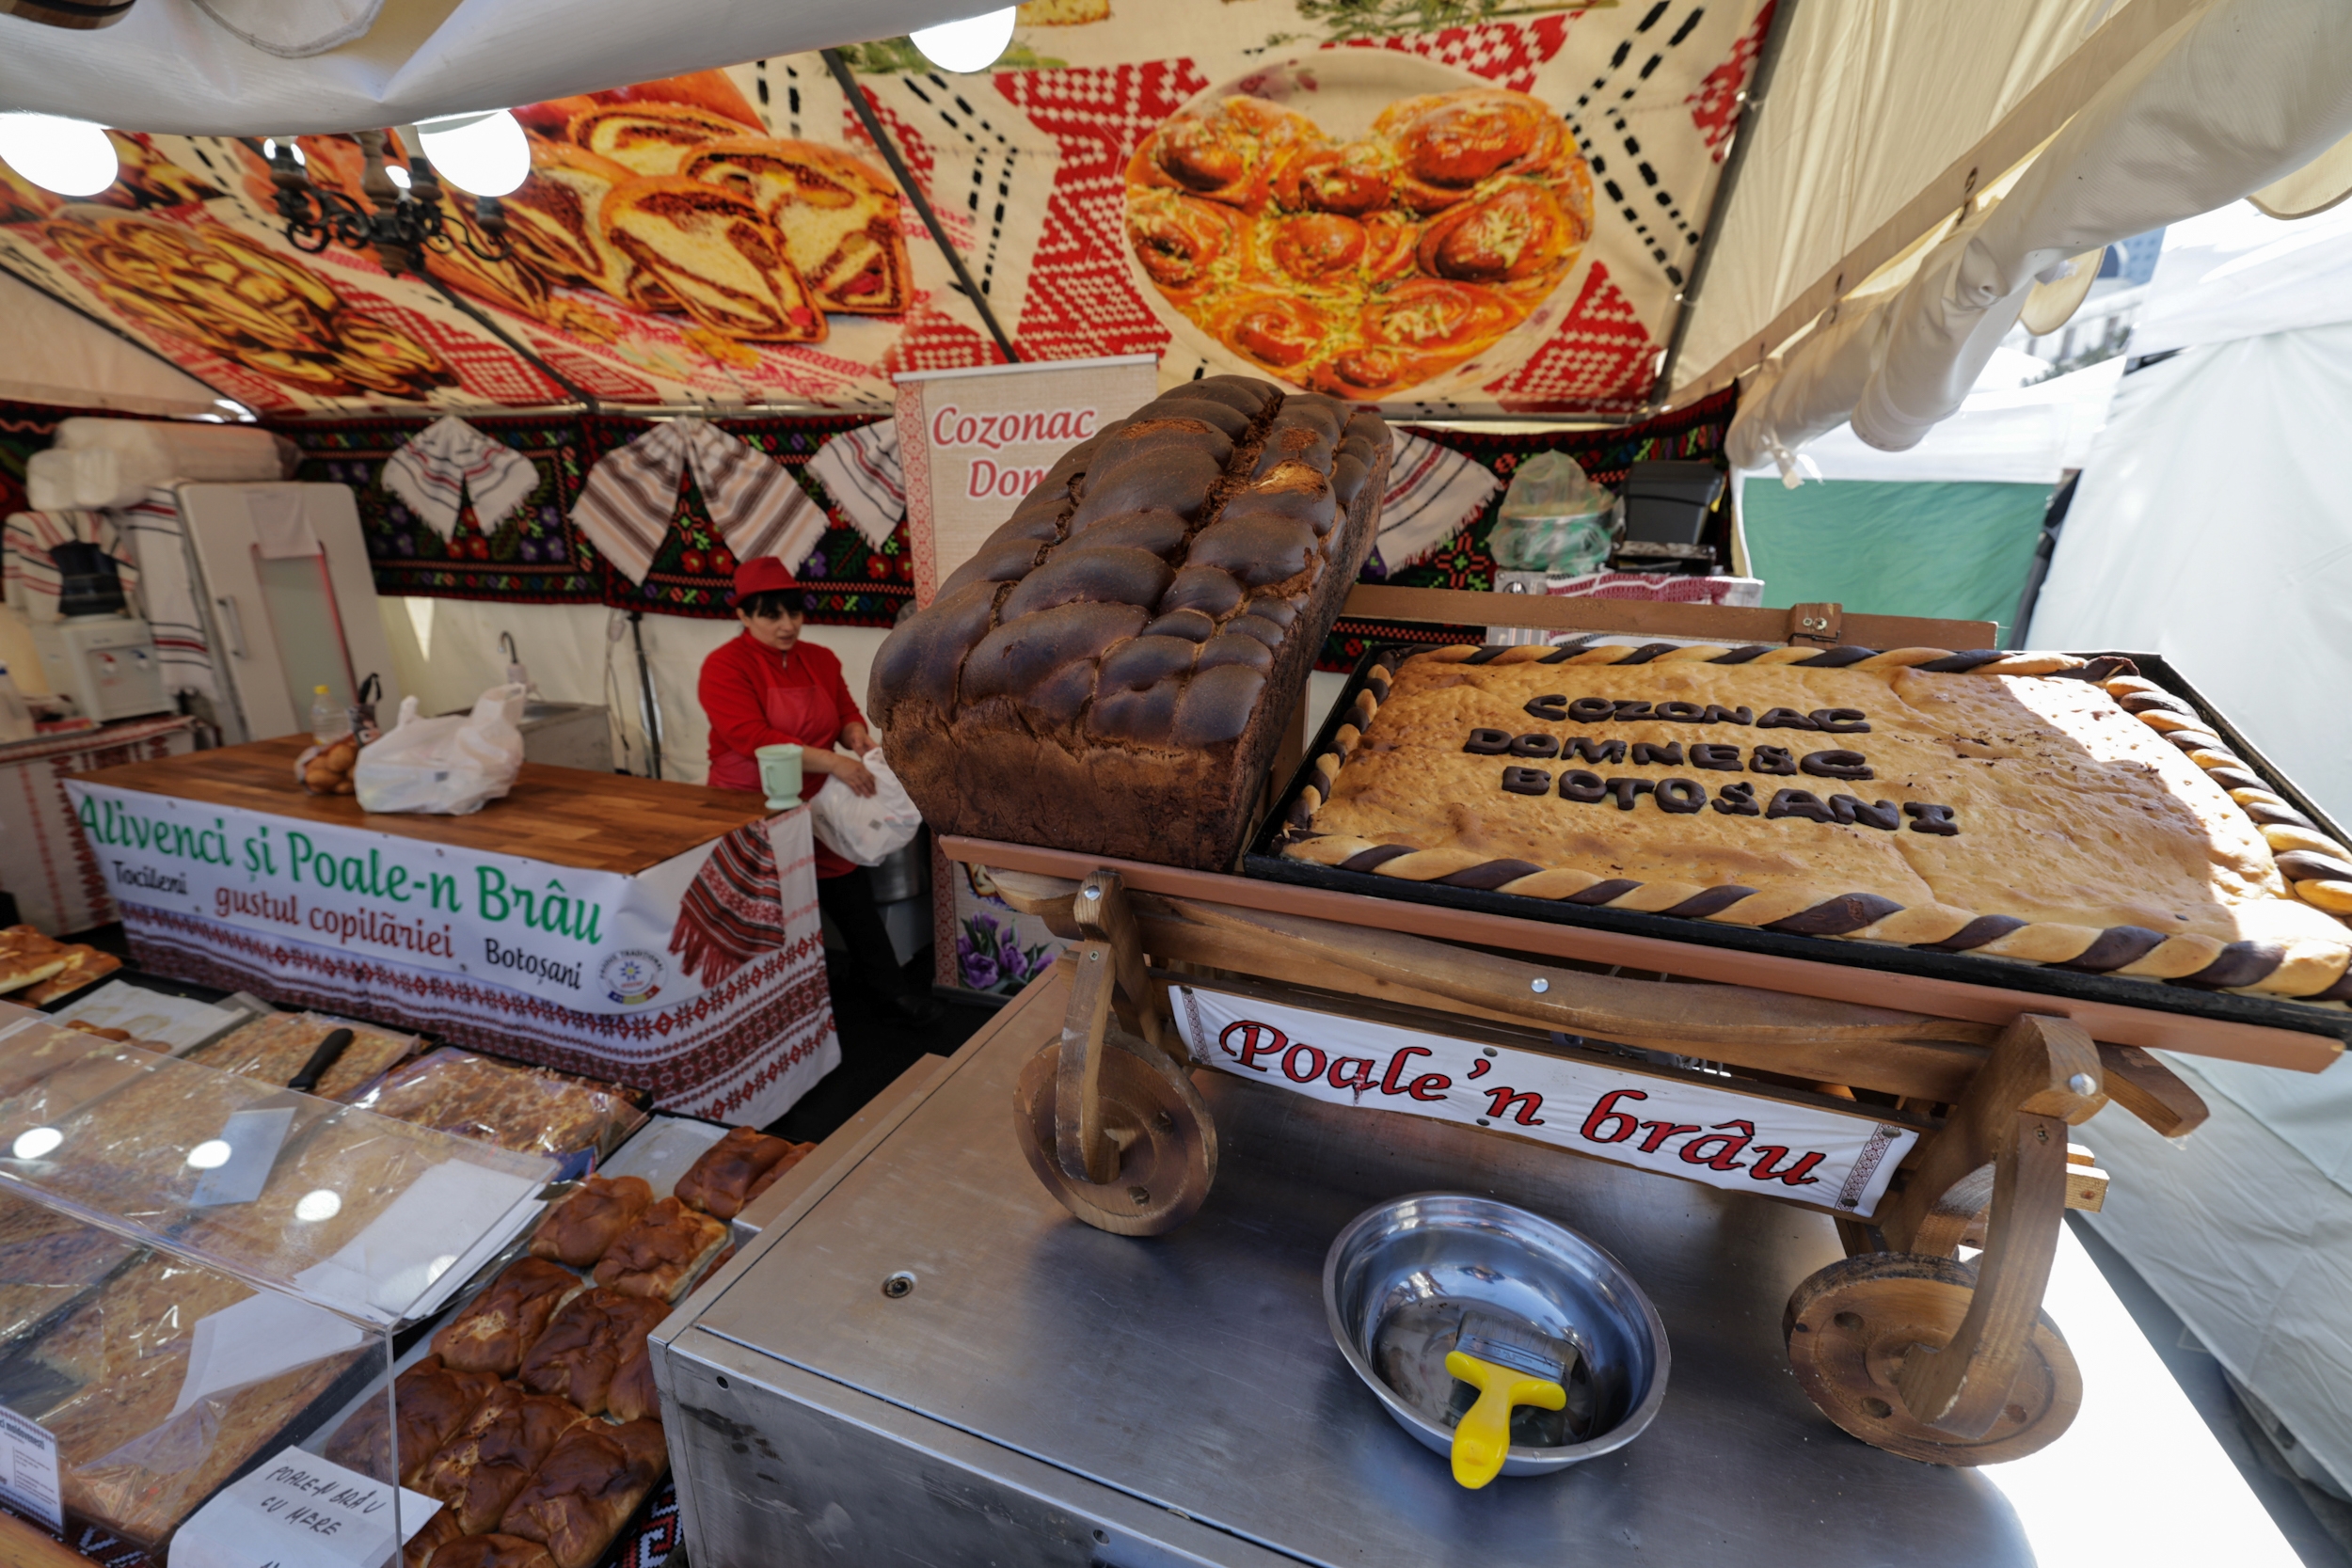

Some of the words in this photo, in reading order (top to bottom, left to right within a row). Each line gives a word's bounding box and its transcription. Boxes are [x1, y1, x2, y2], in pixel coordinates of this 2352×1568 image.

[932, 406, 1095, 450] Cozonac
[1523, 694, 1871, 733] COZONAC
[1463, 728, 1874, 780] DOMNESC
[1502, 765, 1959, 835] BOTOSANI
[79, 795, 233, 866] Alivenci
[244, 826, 278, 882] și
[286, 832, 463, 912] Poale-n
[475, 865, 602, 945] Brâu
[112, 861, 187, 895] Tocileni
[215, 887, 300, 926] gustul
[485, 938, 582, 990] Botoșani
[1580, 1089, 1828, 1187] brâu
[261, 1497, 288, 1513] CU
[285, 1506, 342, 1535] MERE
